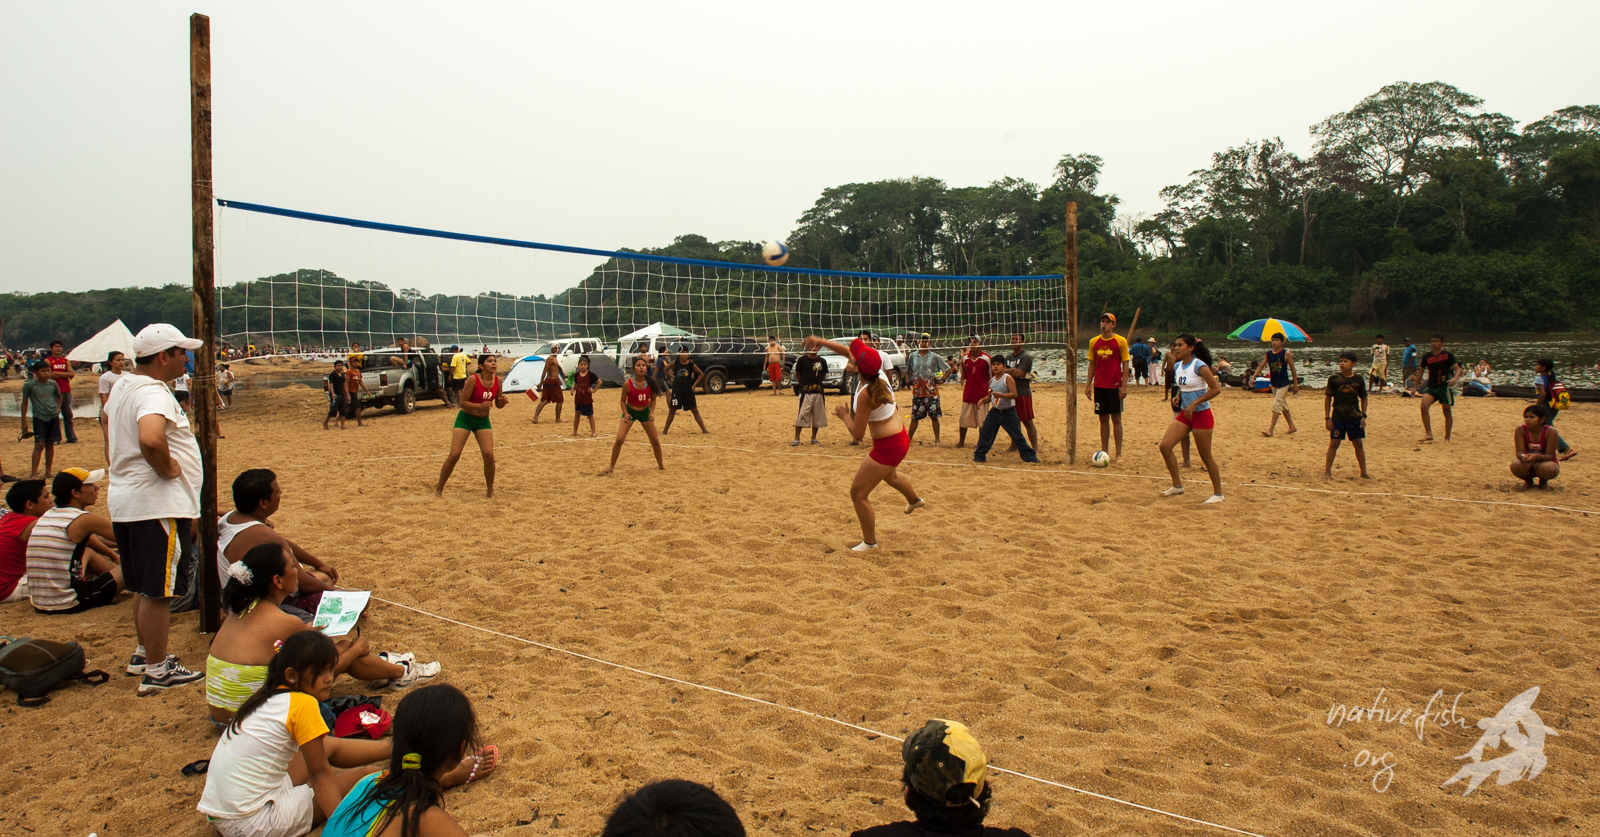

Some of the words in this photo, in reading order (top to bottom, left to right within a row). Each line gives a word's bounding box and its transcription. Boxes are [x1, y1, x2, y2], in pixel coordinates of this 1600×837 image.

[1178, 376, 1187, 386] 02
[482, 391, 493, 400] 02
[638, 393, 646, 401] 01
